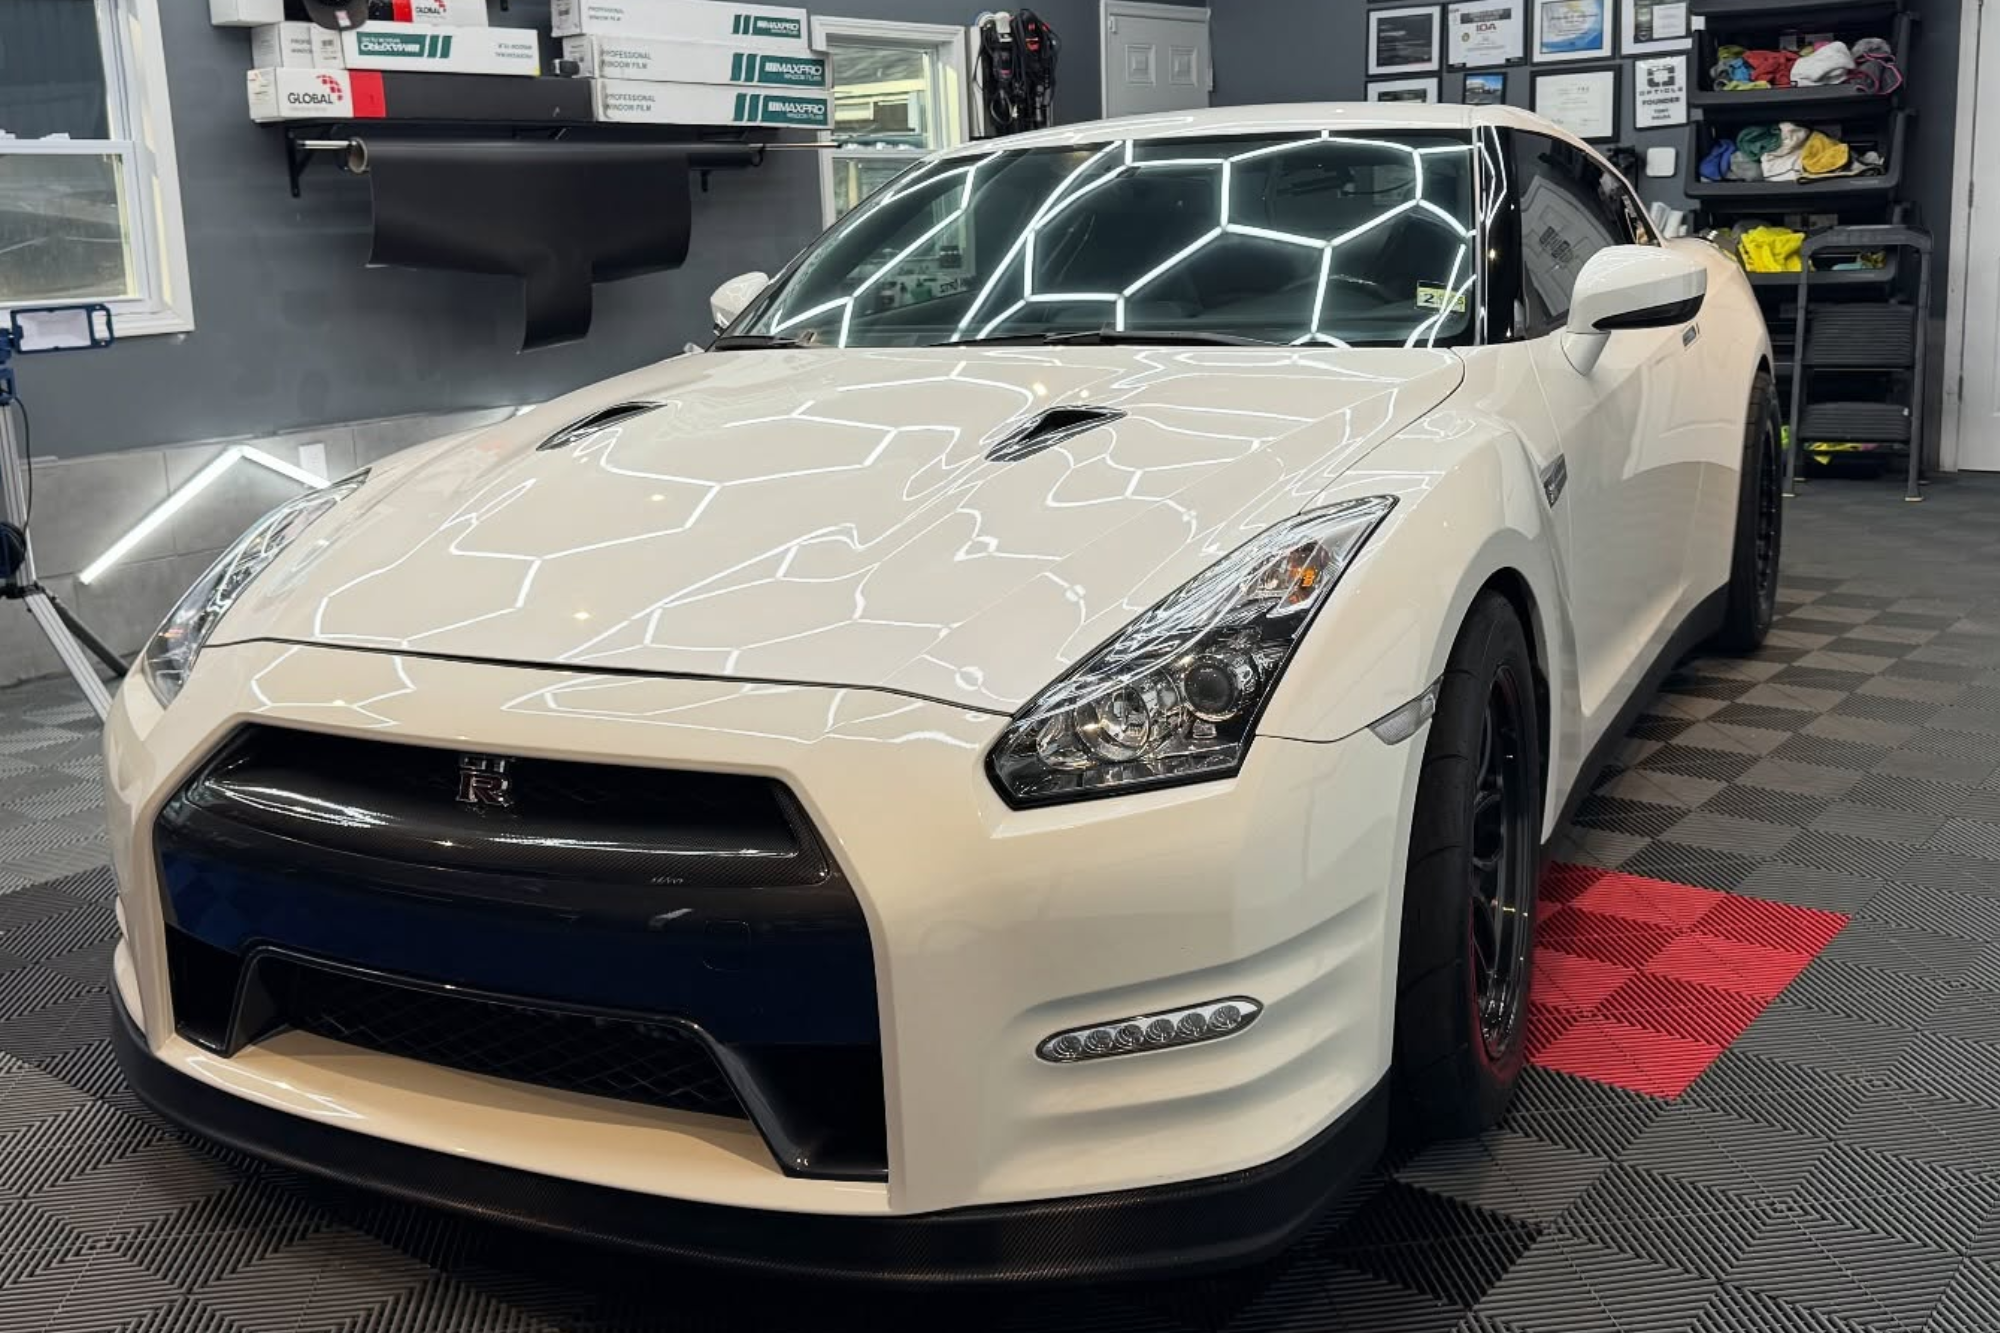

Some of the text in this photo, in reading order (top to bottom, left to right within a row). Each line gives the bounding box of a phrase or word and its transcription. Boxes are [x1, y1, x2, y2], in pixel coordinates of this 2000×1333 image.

[766, 22, 799, 31] MAXPRO
[601, 50, 652, 60] PROFESSIONAL
[602, 60, 631, 68] WINDOW
[775, 63, 822, 75] MAXPRO
[287, 92, 334, 105] GLOBAL
[605, 93, 656, 102] PROFESSIONAL
[1642, 97, 1681, 105] FOUNDER
[605, 104, 634, 112] WINDOW
[777, 102, 825, 115] MAXPRO
[1423, 293, 1434, 305] 2
